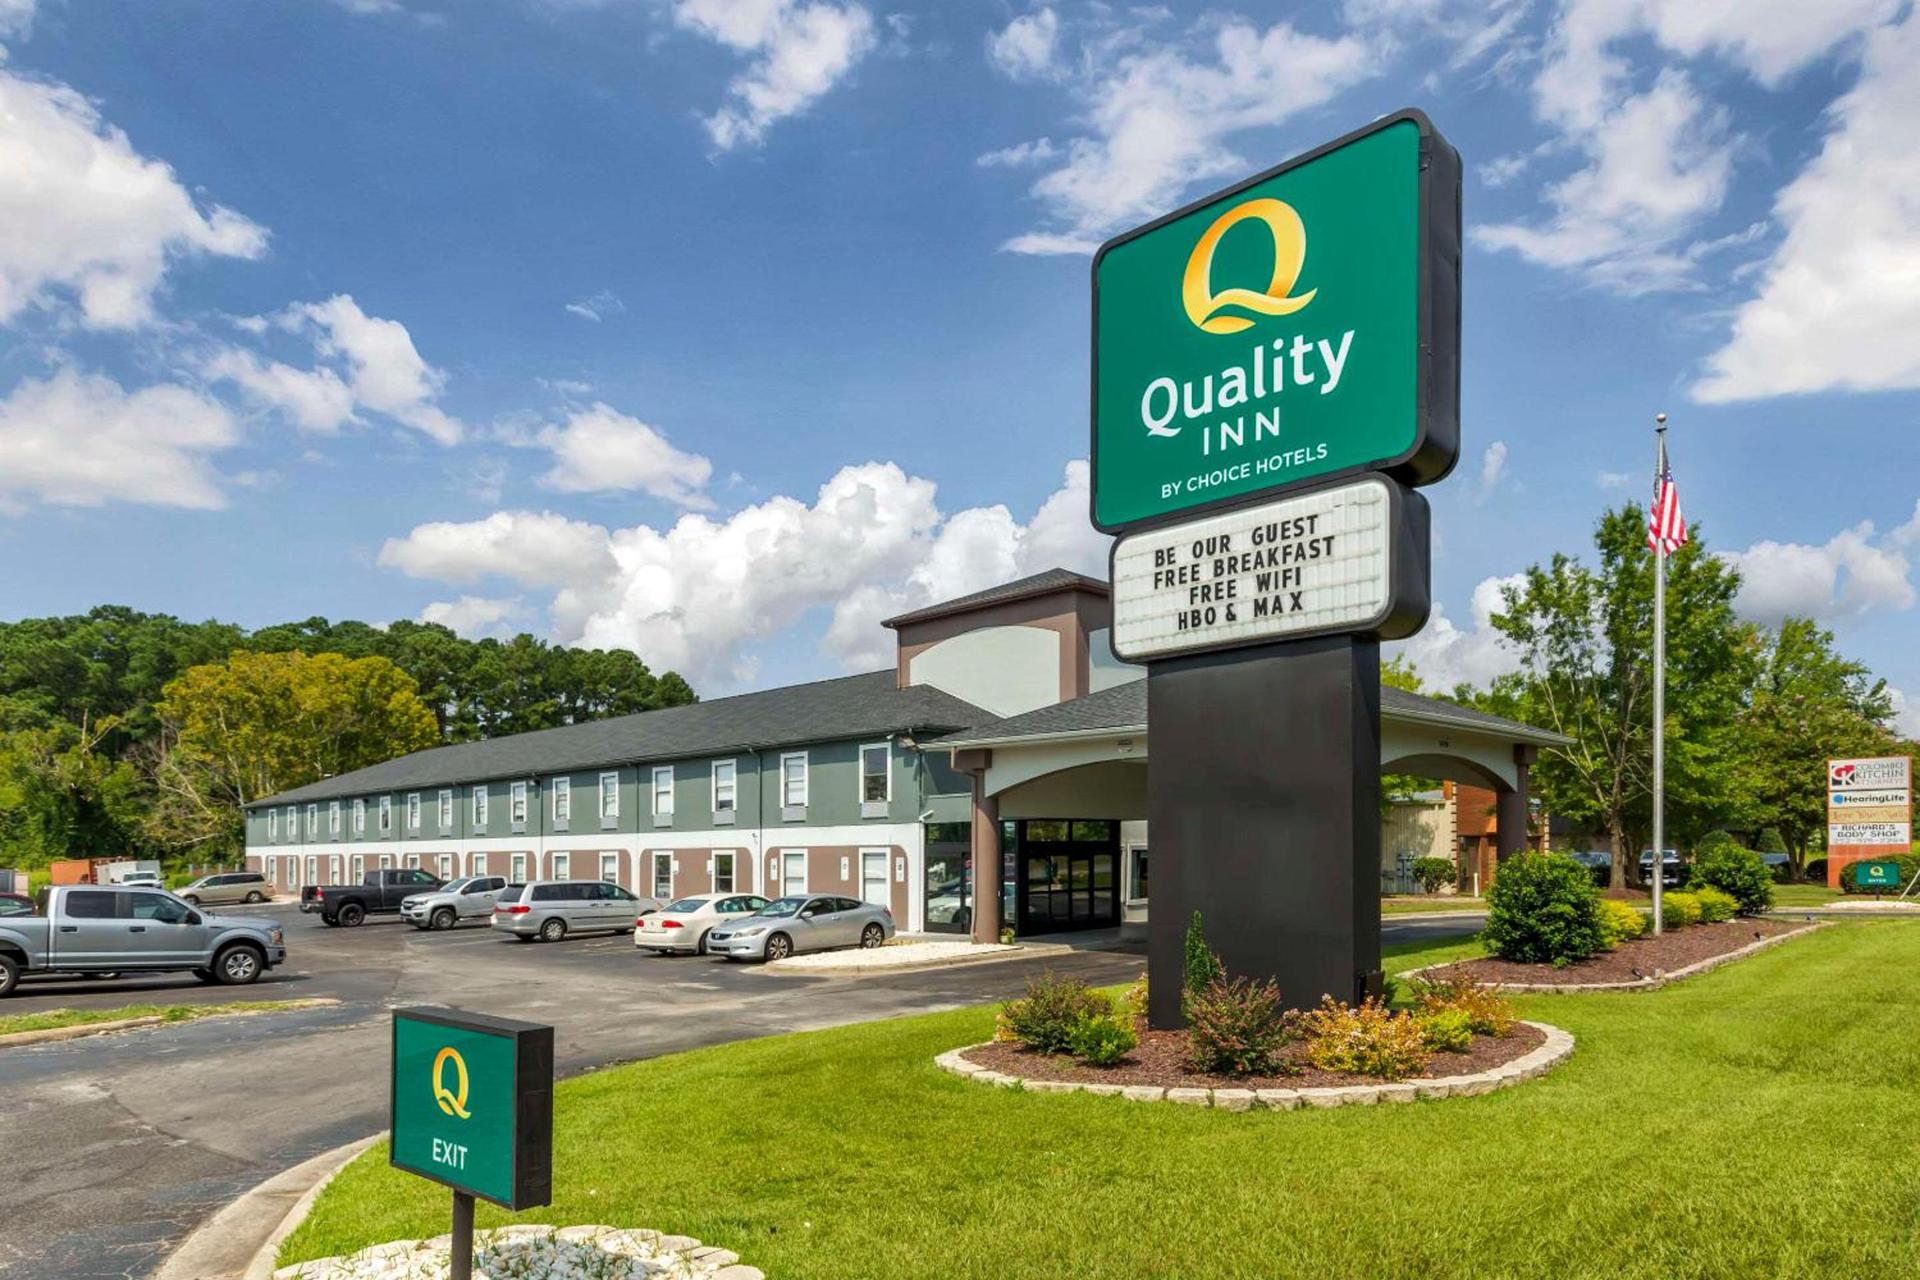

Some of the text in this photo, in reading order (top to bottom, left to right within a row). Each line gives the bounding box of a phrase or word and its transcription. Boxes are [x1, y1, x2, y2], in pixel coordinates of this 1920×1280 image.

[1141, 330, 1355, 437] Quality
[1203, 407, 1280, 455] INN
[1161, 443, 1327, 499] BY CHOICE HOTELS
[1154, 514, 1318, 568] BE OUR GUEST
[1154, 535, 1335, 590] FREE BREAKFAST
[1189, 567, 1301, 605] FREE WIFI
[1178, 591, 1303, 630] HBO & MAX
[1855, 768, 1904, 779] KITCHIN
[1844, 794, 1905, 803] HearingLife
[1870, 830, 1900, 838] SHOP
[432, 1137, 468, 1170] EXIT
